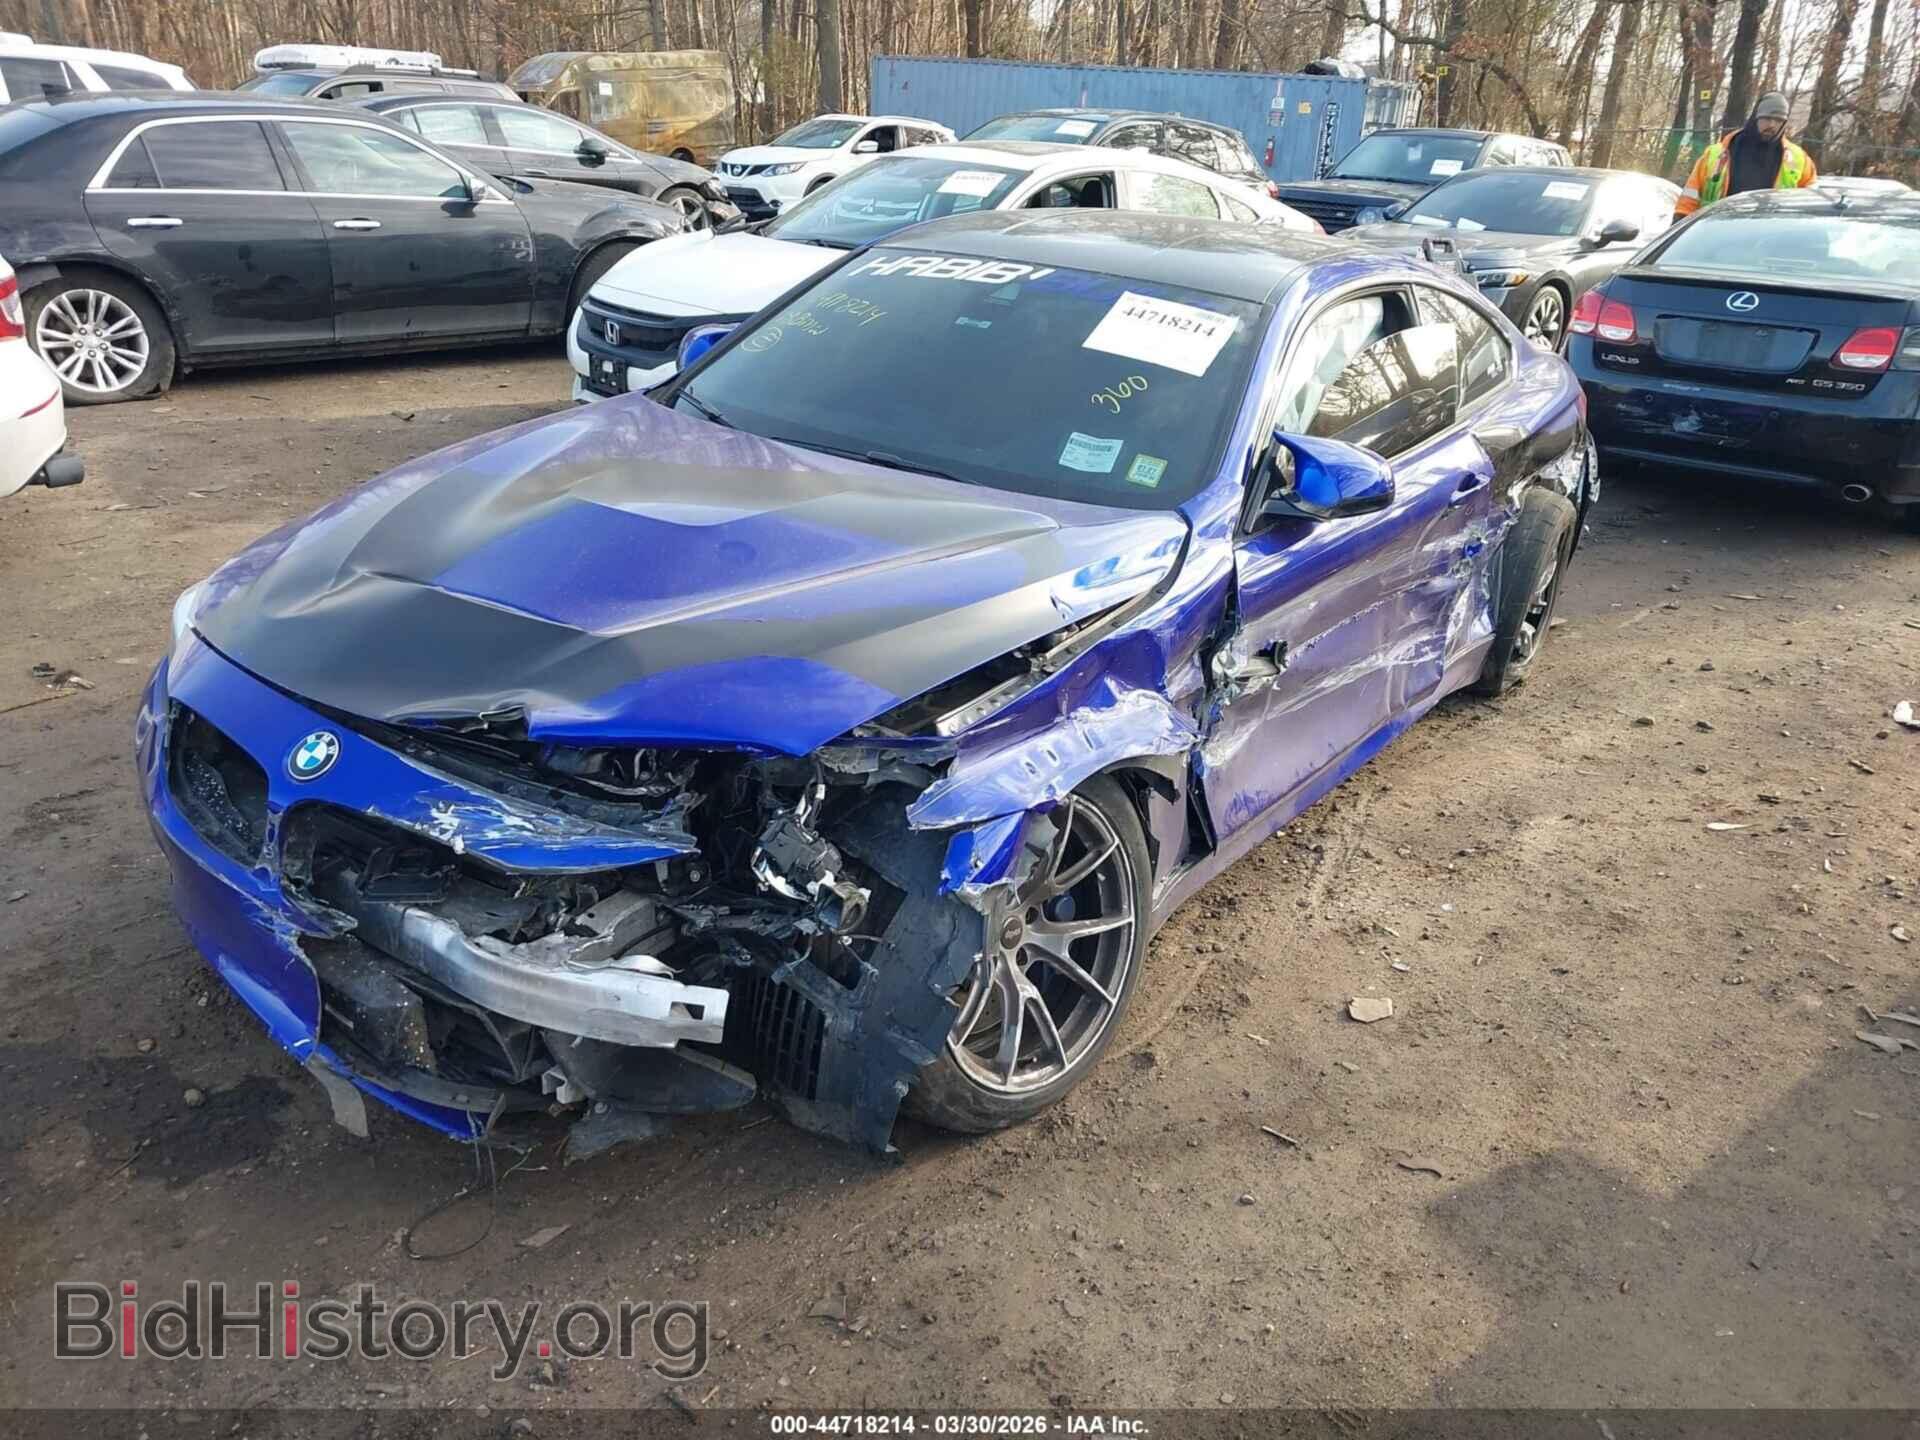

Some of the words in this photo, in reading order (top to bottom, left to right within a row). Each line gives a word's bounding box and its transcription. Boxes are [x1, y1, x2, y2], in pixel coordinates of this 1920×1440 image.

[1122, 306, 1217, 337] 44718214
[1601, 353, 1640, 365] LEXUS
[1091, 375, 1148, 414] 360
[1812, 379, 1833, 388] GS
[1835, 381, 1866, 391] 350
